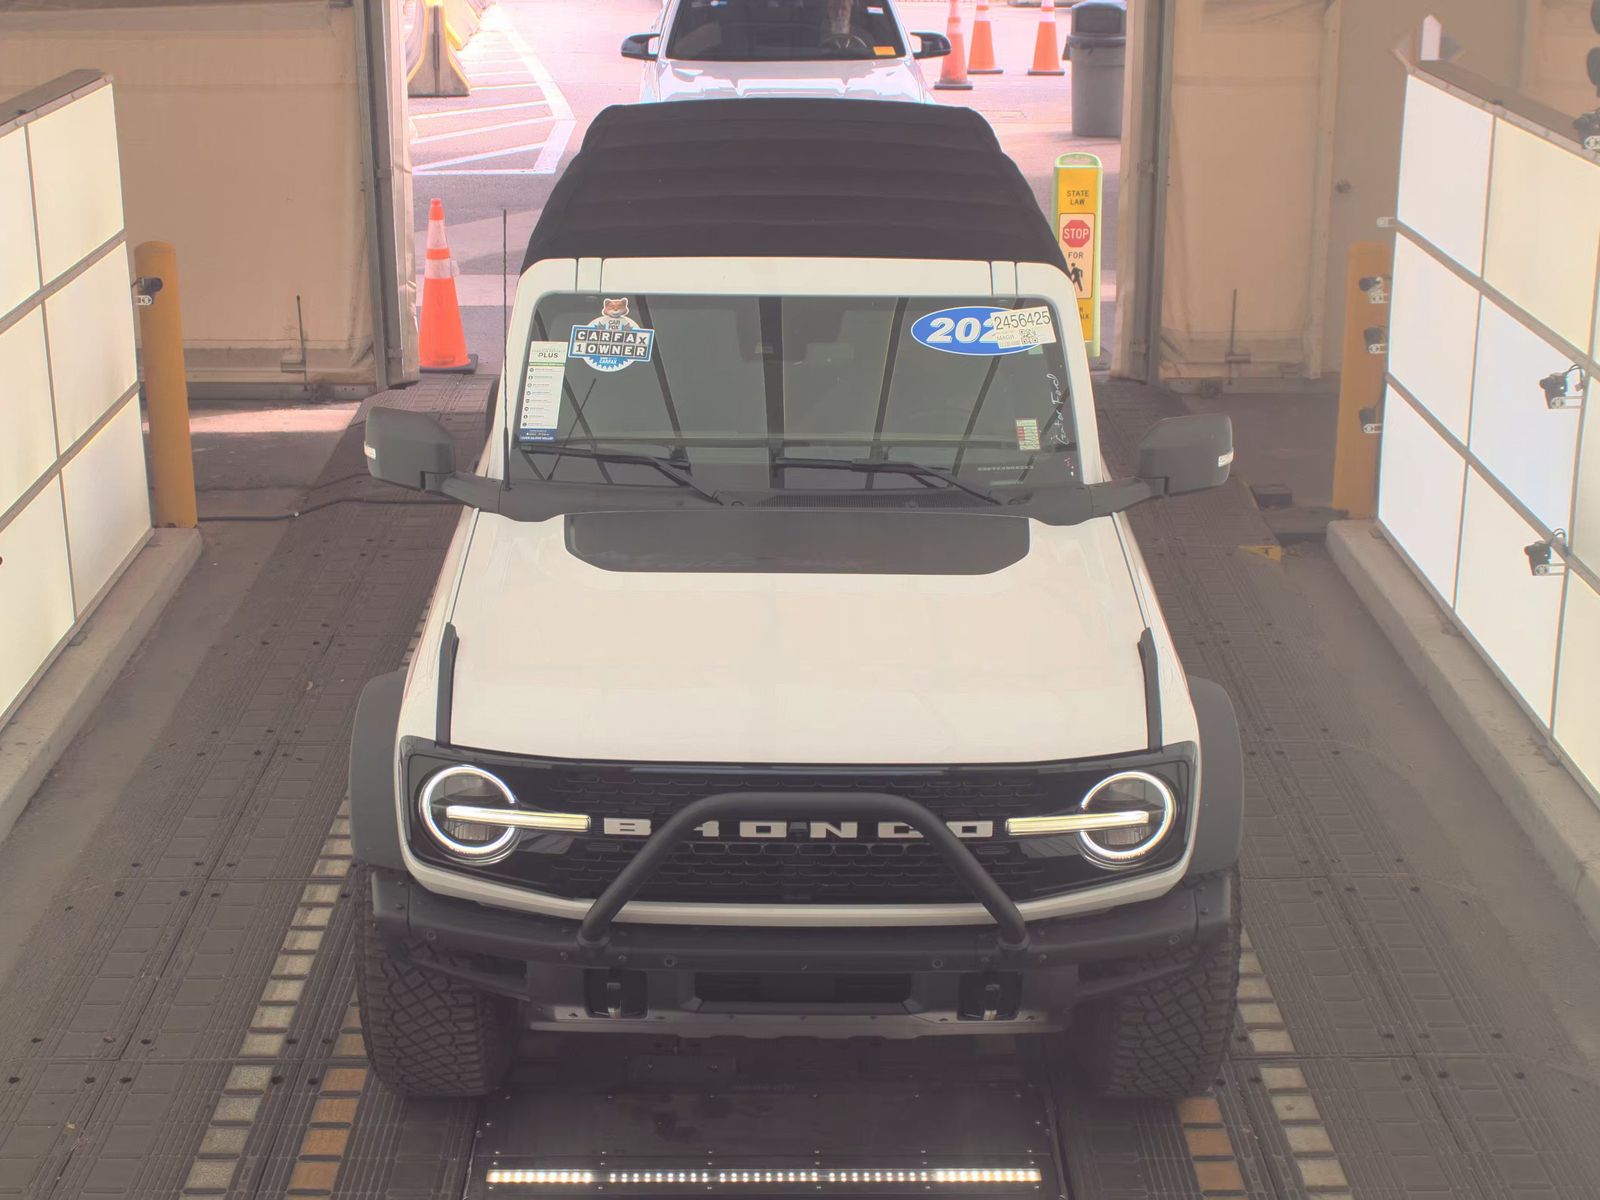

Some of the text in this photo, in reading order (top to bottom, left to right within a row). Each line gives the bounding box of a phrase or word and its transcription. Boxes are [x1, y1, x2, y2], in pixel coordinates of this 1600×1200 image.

[1063, 228, 1089, 239] STOP
[1068, 251, 1084, 259] FOR
[994, 310, 1051, 330] 2456425
[926, 317, 999, 343] 202
[577, 331, 647, 345] CARFAX
[576, 344, 646, 356] 1 OWNER
